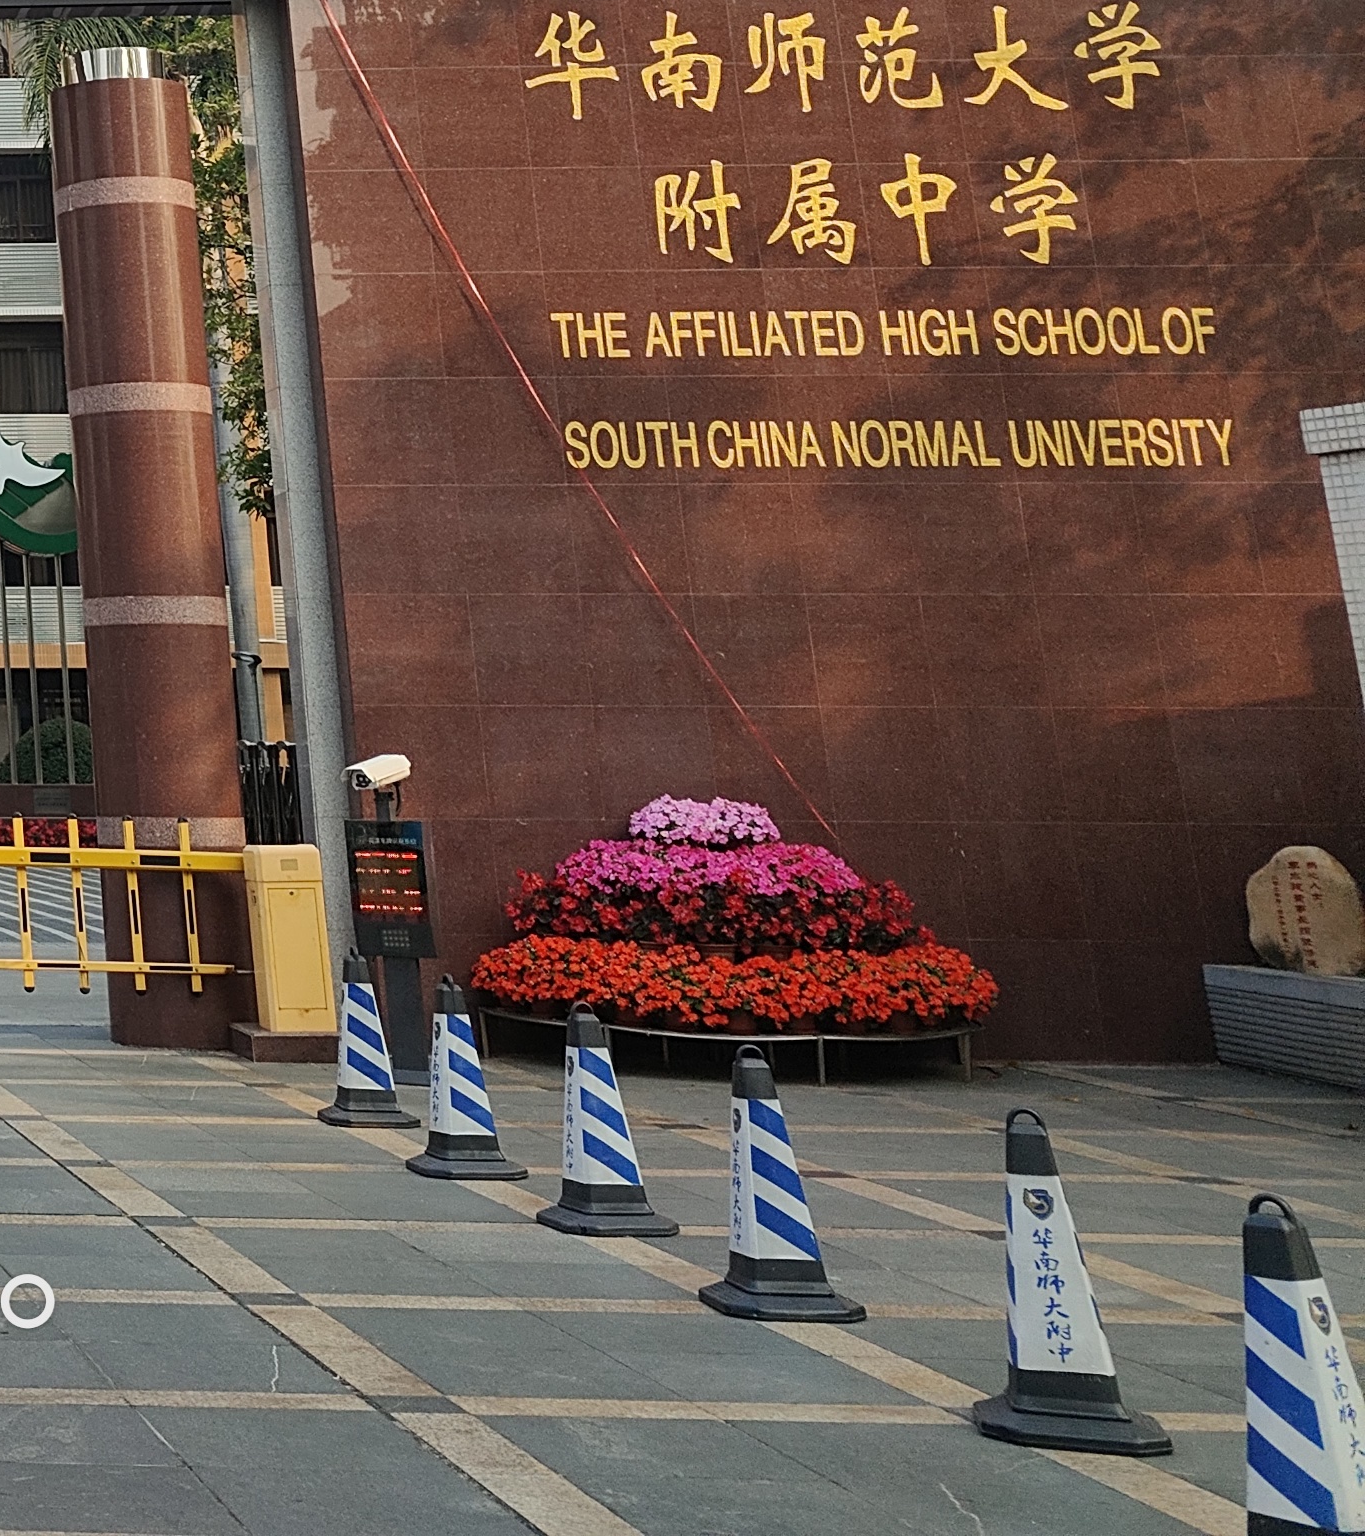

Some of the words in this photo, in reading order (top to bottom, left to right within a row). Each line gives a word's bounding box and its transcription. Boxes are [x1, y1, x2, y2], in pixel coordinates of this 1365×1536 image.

[525, 1, 1162, 119] 华南师范大学
[654, 153, 1078, 266] 附属中学
[550, 312, 630, 358] THE
[646, 309, 865, 357] AFFILIATED
[879, 308, 980, 356] HIGH
[565, 420, 700, 469] SOUTH
[707, 420, 826, 468] CHINA
[831, 419, 1002, 468] NORMAL
[1007, 418, 1232, 468] UNIVERSITY
[1033, 1227, 1074, 1364] 华南师大附中
